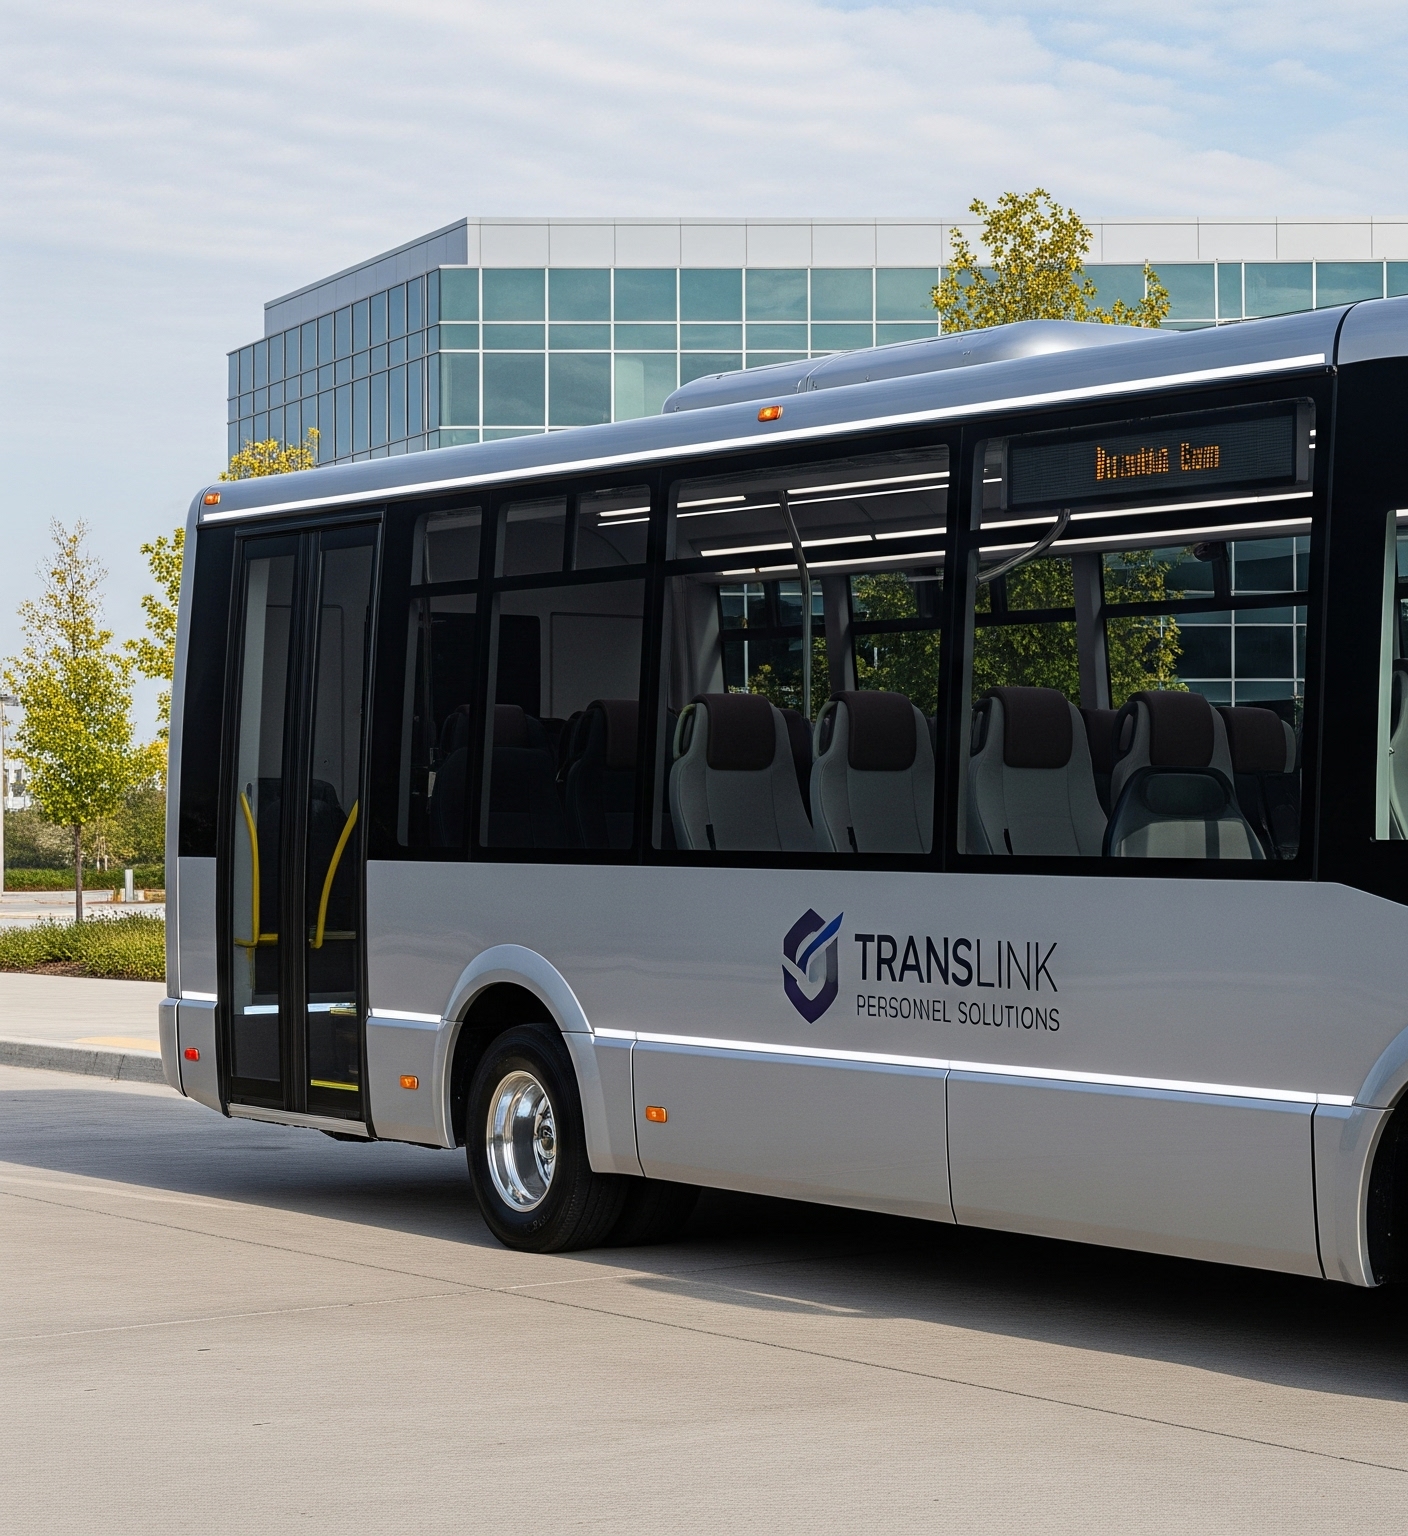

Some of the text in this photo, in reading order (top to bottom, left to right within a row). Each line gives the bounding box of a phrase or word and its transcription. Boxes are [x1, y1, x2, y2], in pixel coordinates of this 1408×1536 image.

[854, 933, 1059, 993] TRANSLINK
[856, 994, 1061, 1032] PERSONNEL SOLUTIONS
